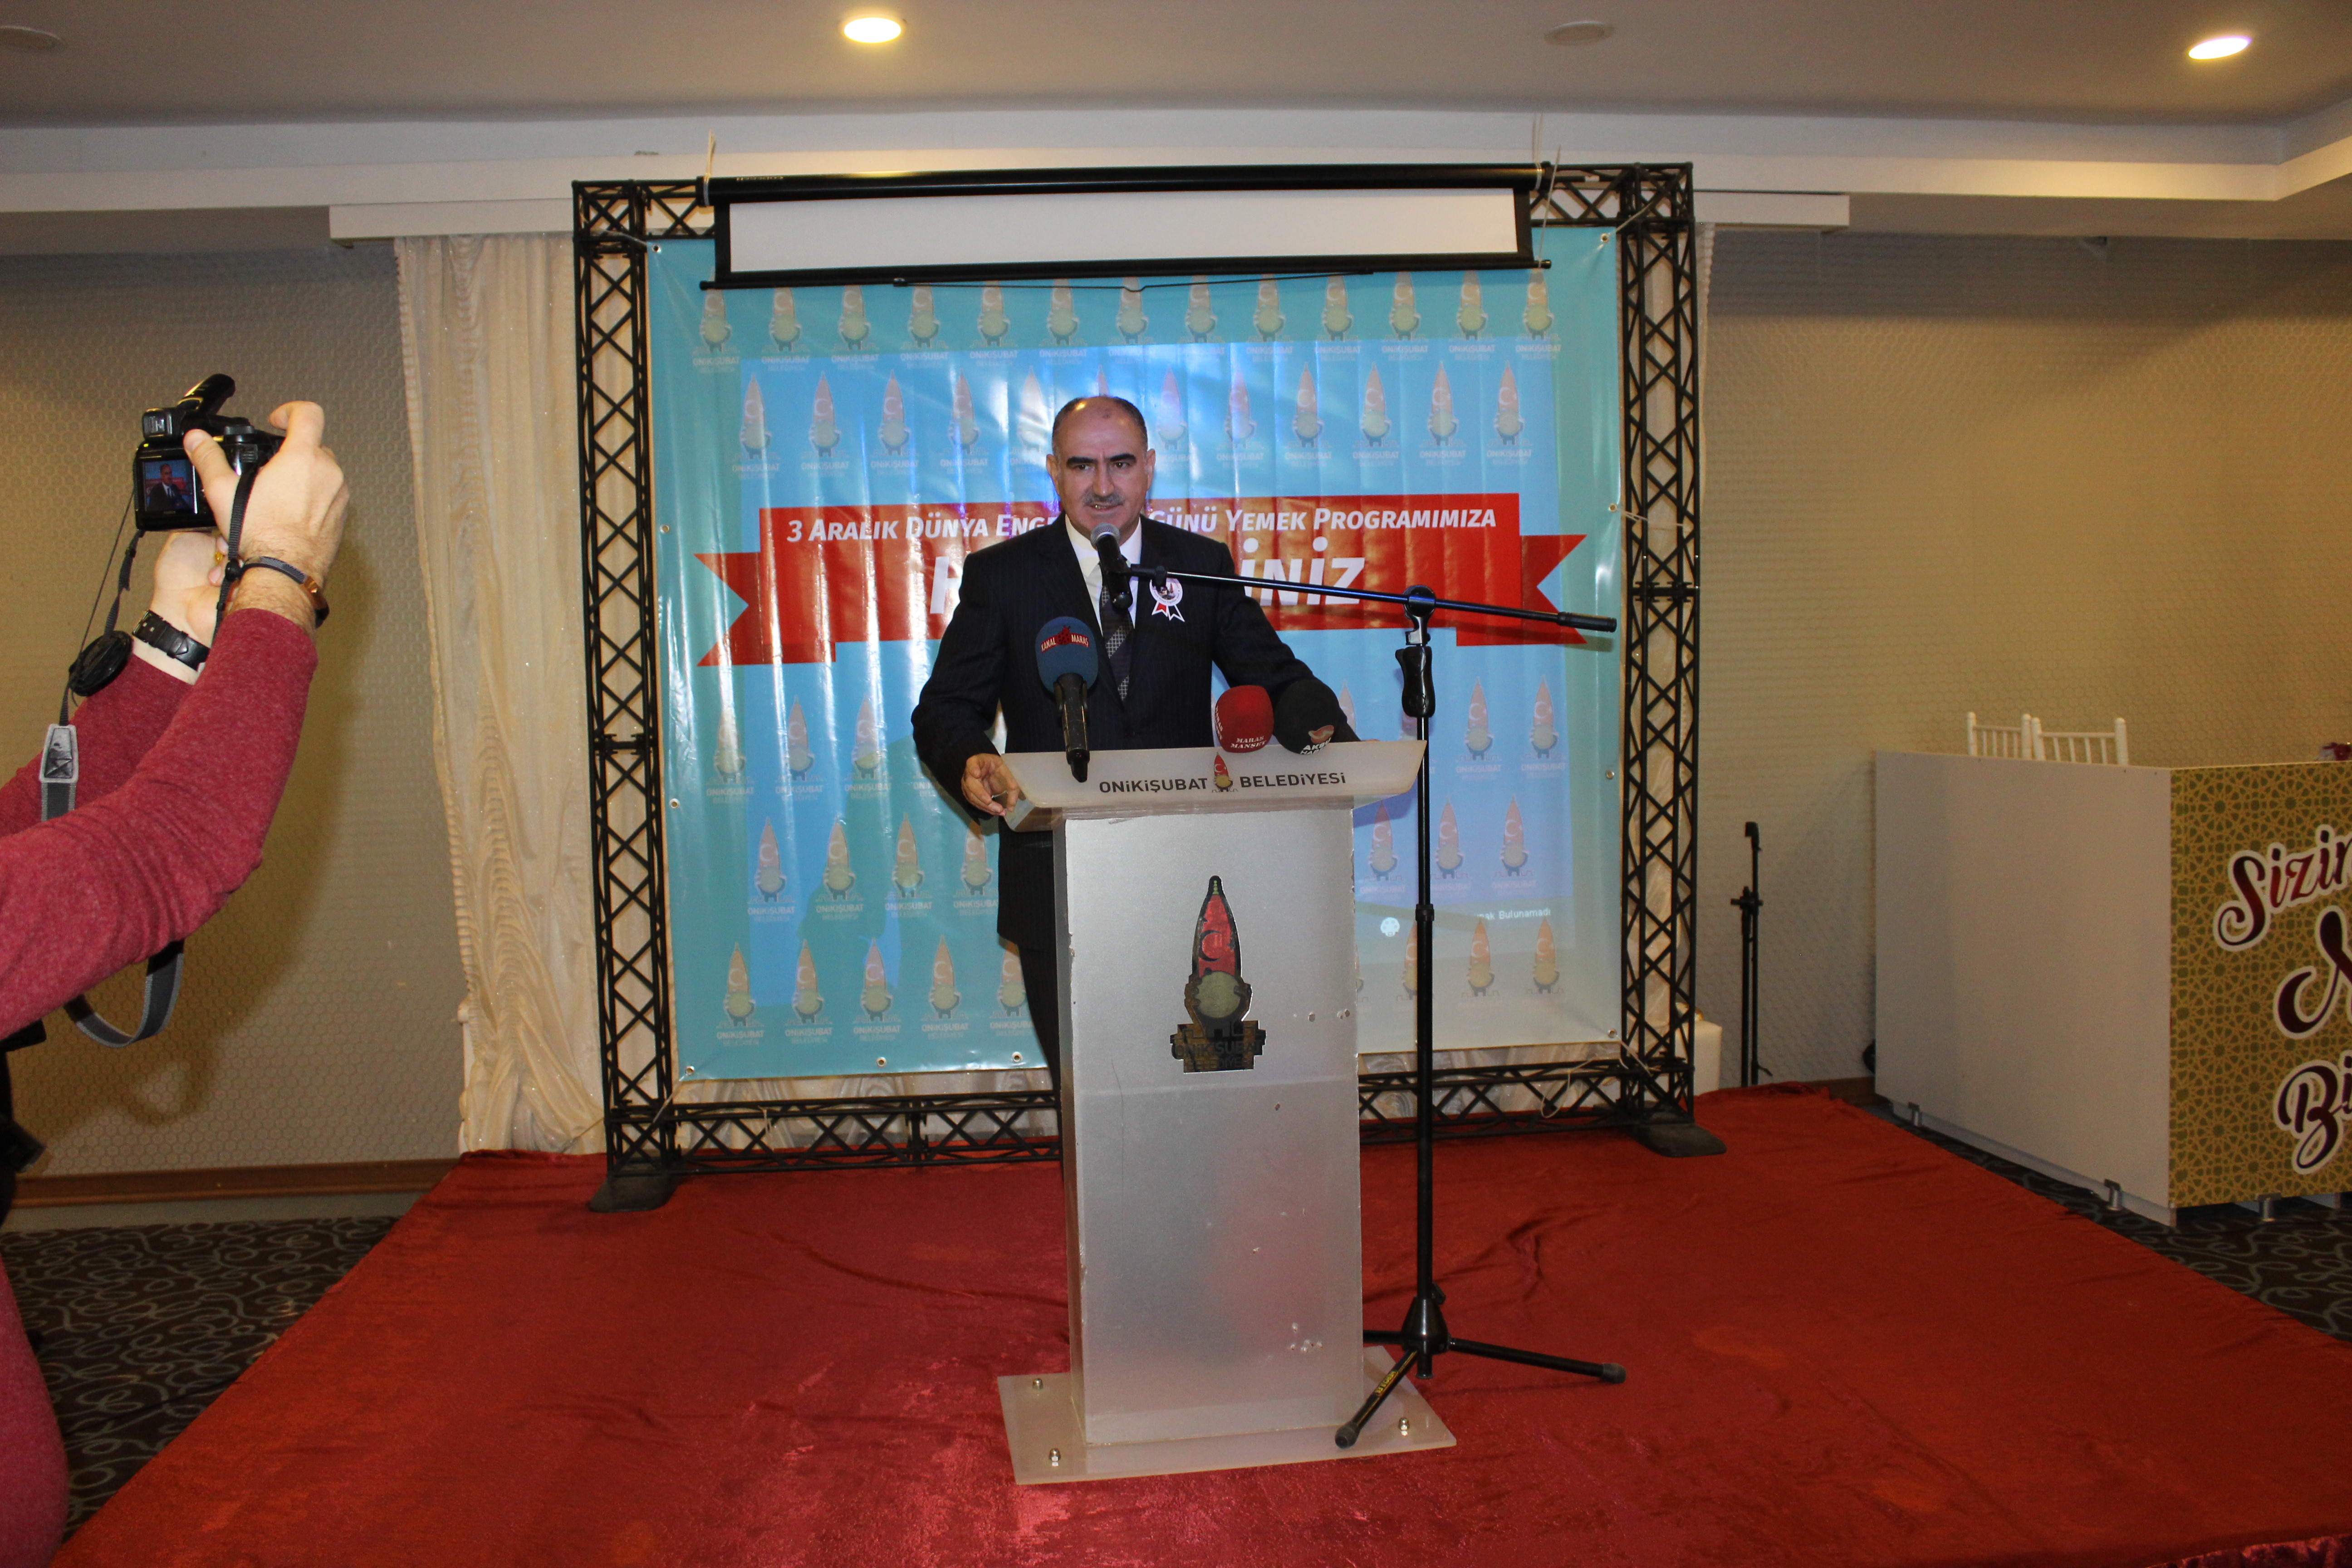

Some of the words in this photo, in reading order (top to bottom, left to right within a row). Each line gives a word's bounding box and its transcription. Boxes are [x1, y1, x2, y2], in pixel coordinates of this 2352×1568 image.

[787, 520, 802, 542] 3
[808, 519, 899, 541] ARALIK
[907, 512, 988, 538] DÜNYA
[1226, 509, 1307, 531] YEMEK
[1313, 508, 1496, 529] PROGRAMIMIZA
[1041, 637, 1056, 652] KANAL
[1071, 634, 1089, 647] MARAŞ
